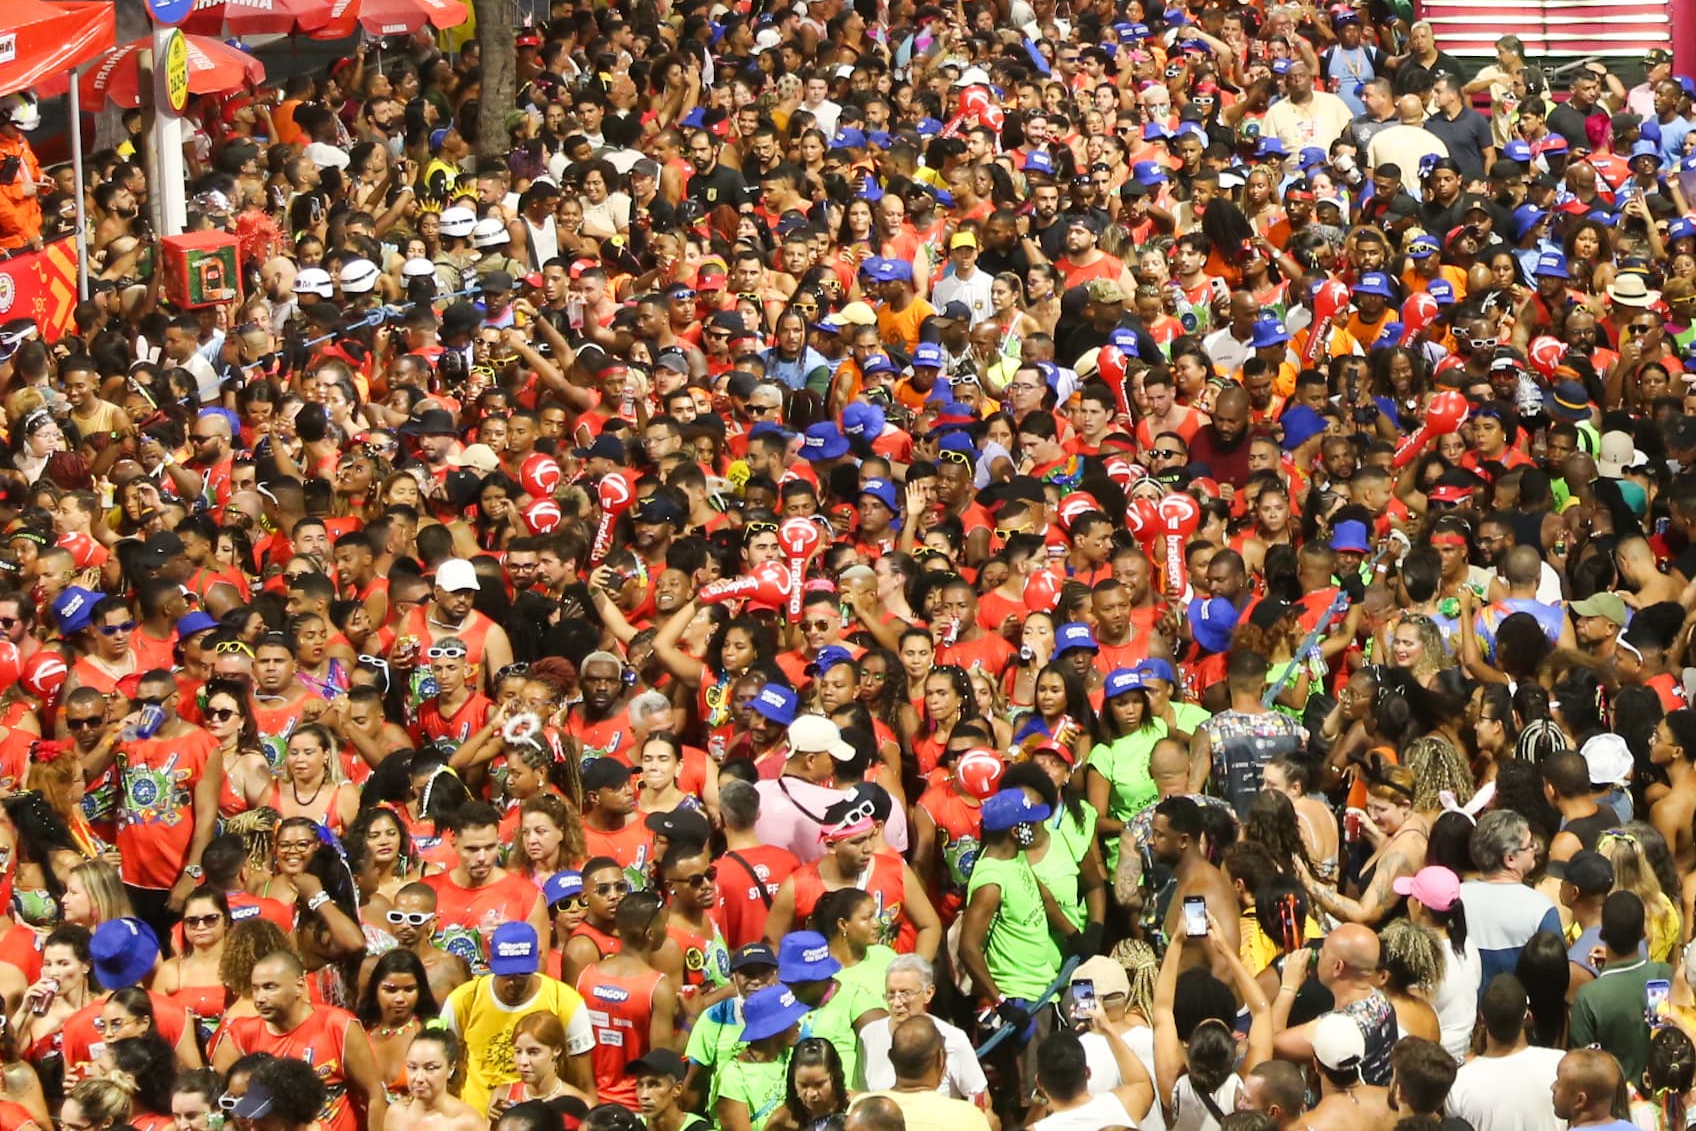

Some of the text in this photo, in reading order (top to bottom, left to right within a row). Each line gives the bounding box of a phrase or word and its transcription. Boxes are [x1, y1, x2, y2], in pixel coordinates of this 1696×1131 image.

[94, 44, 136, 90] BRAHMA
[591, 510, 614, 562] bradeso
[790, 557, 805, 615] bradesco
[749, 882, 780, 899] STFF
[592, 987, 628, 1001] ENGOV
